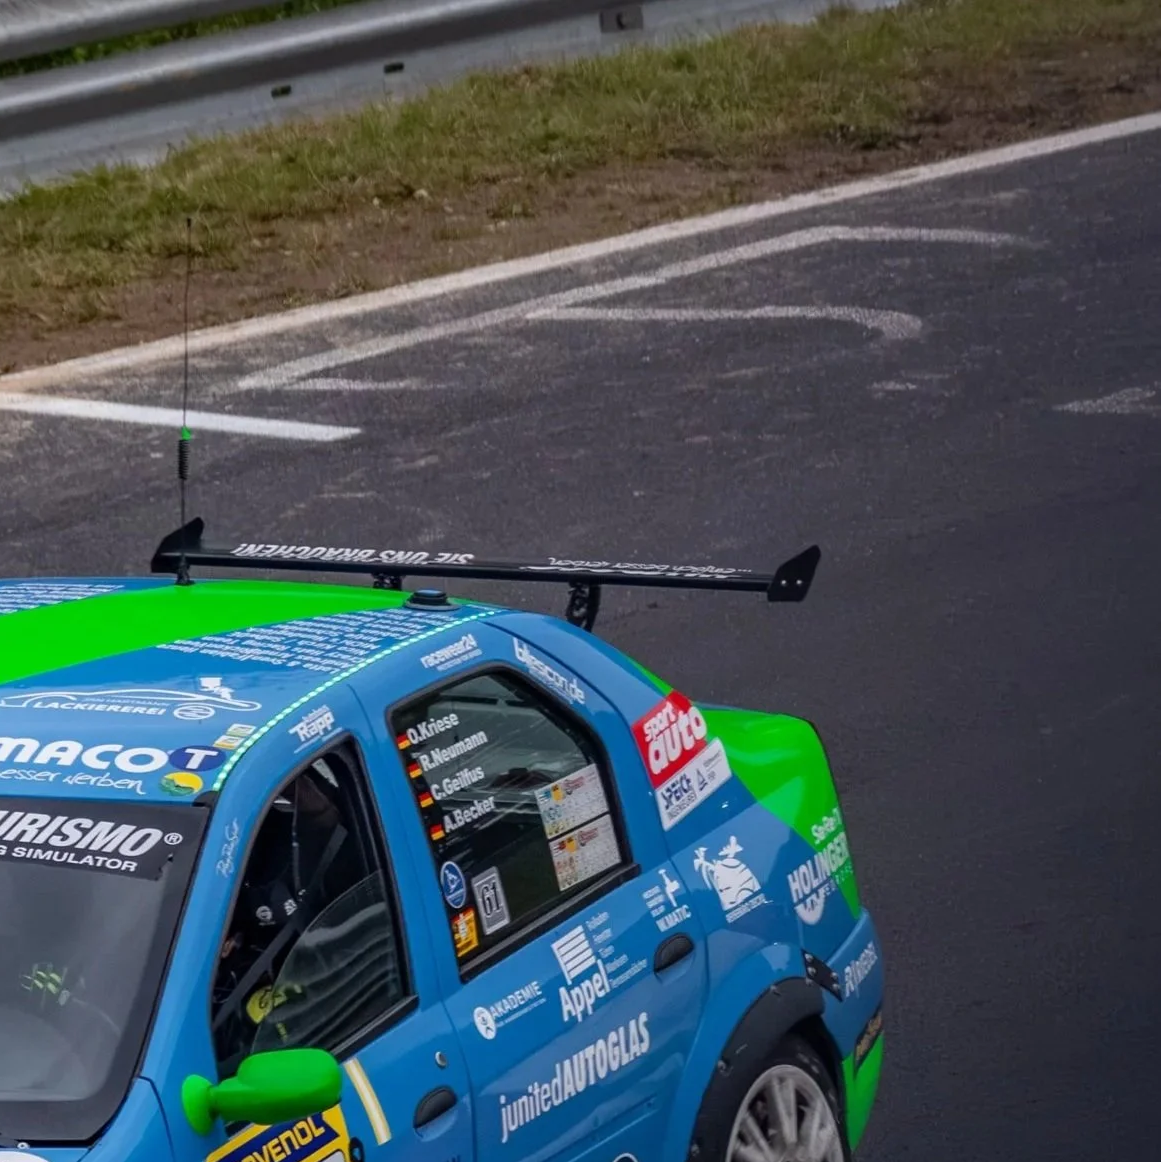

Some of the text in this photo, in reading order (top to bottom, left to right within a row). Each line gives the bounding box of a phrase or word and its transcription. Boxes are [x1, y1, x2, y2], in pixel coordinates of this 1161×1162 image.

[34, 702, 166, 716] LACKIEREREI
[185, 748, 219, 770] T
[419, 729, 488, 772] R.Neumann
[649, 706, 708, 774] auto
[443, 796, 495, 833] A.Becker
[11, 845, 138, 872] SIMULATOR
[787, 832, 850, 904] HOLINGER
[490, 981, 542, 1020] AKADEMIE
[558, 959, 610, 1022] Appel
[499, 1012, 650, 1143] junitedAUTOGLAS
